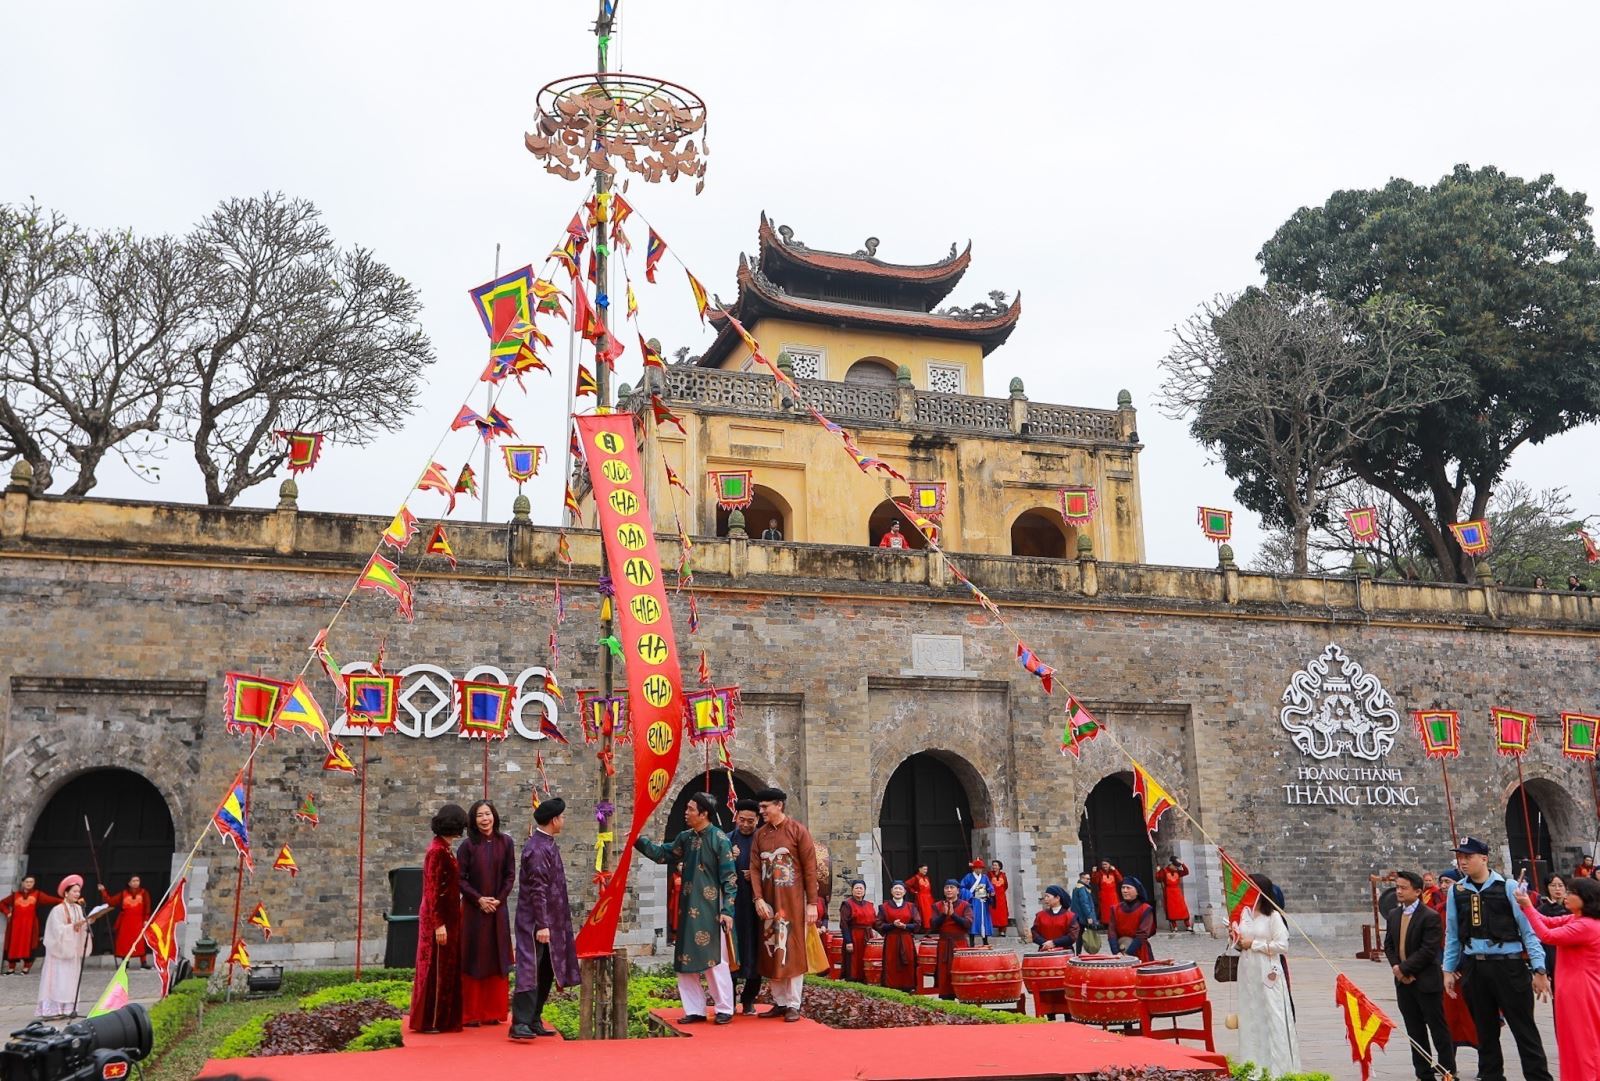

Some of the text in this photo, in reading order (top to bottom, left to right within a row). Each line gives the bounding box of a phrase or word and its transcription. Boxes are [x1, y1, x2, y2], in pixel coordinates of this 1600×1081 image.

[625, 559, 654, 585] AN
[637, 635, 668, 663] HẠ
[1298, 765, 1403, 781] HOÀNG THÀNH
[1282, 781, 1420, 806] THĂNG LONG
